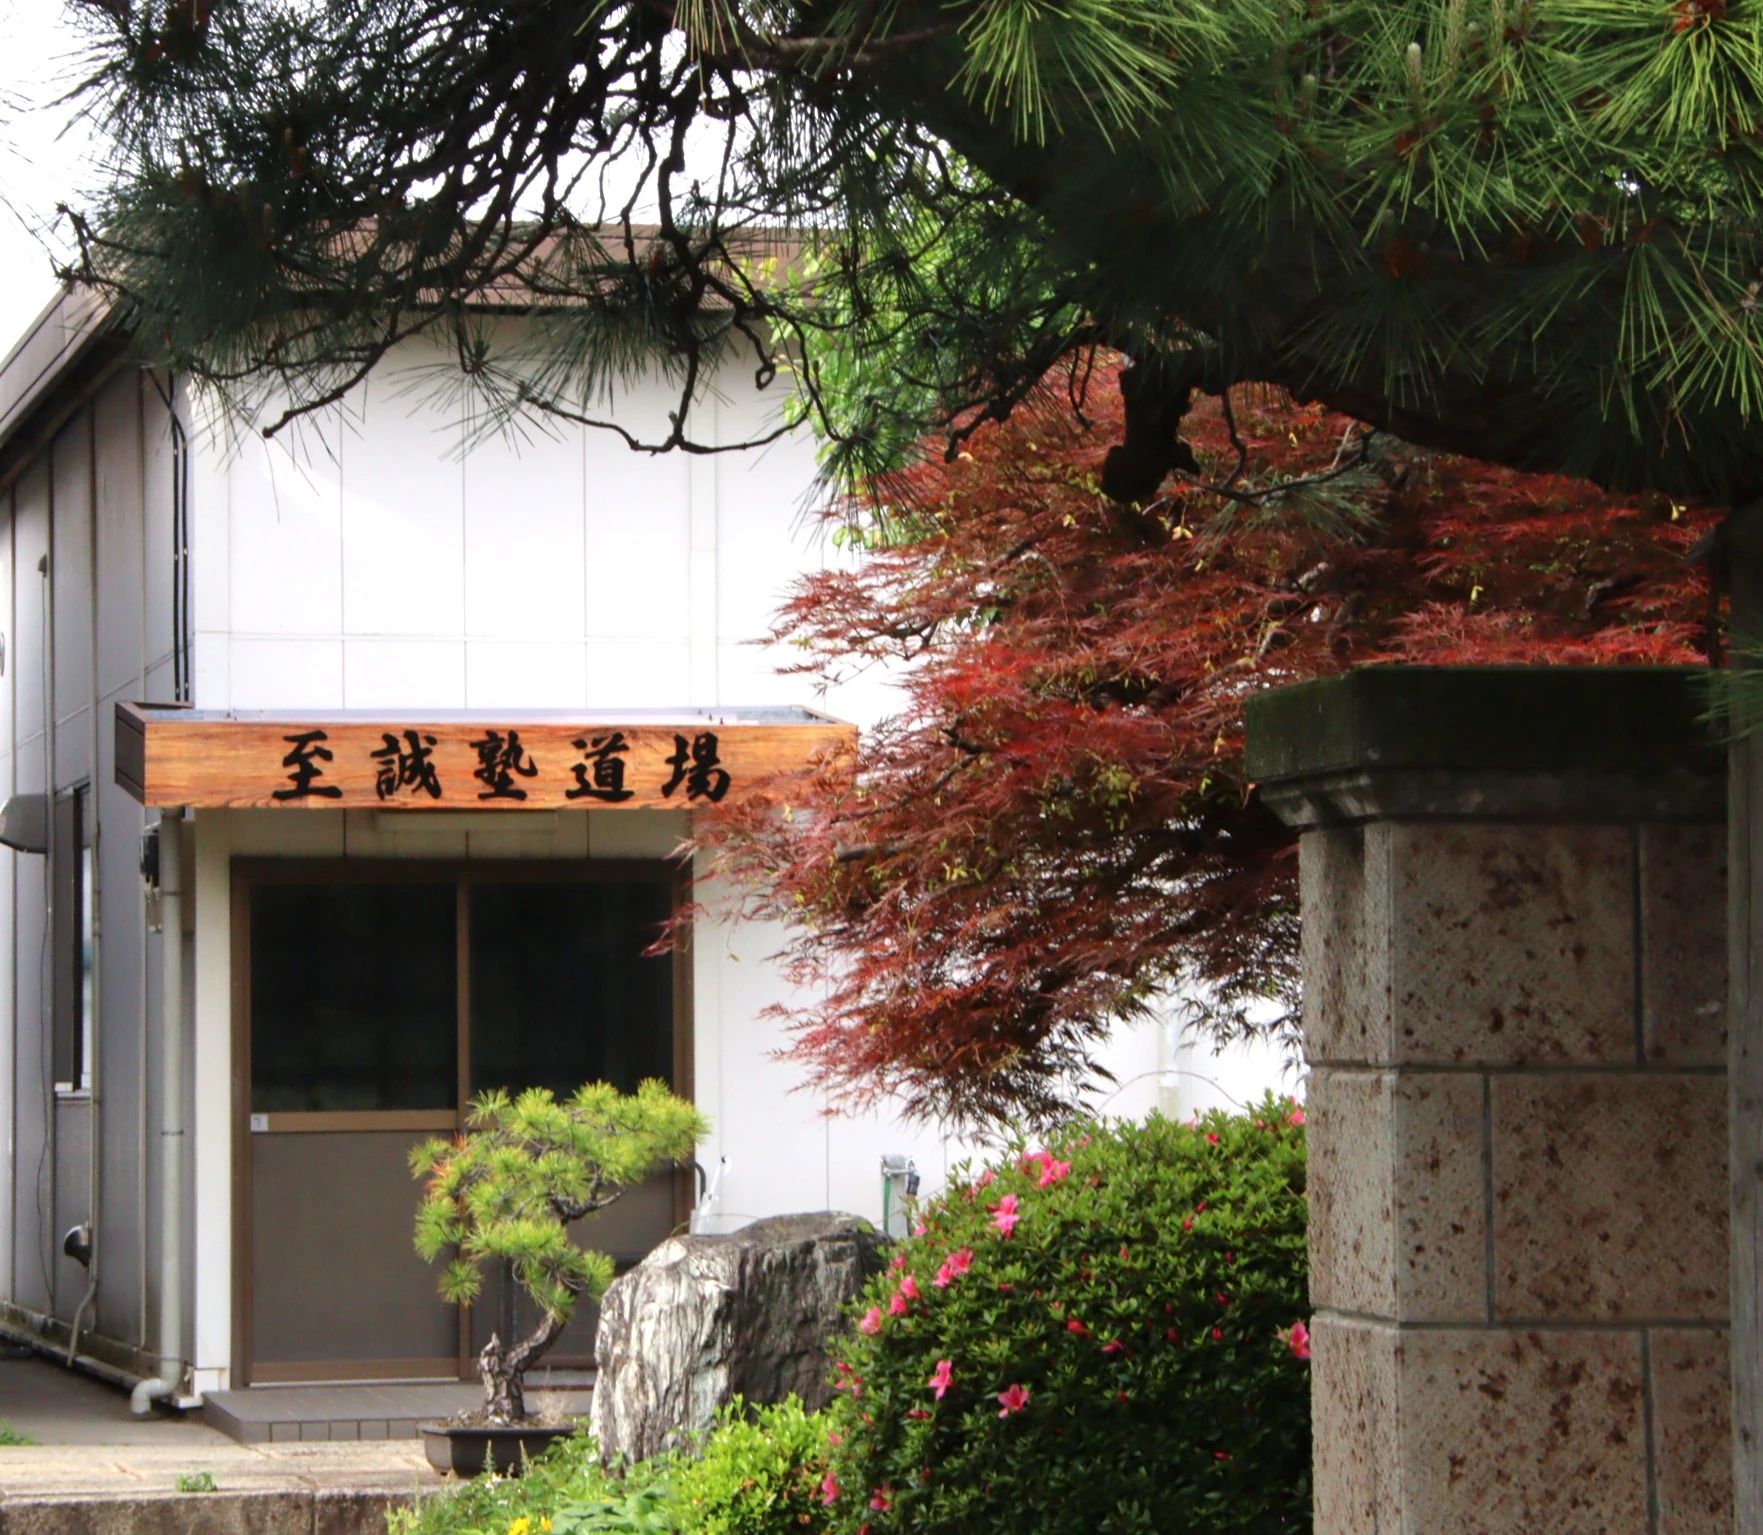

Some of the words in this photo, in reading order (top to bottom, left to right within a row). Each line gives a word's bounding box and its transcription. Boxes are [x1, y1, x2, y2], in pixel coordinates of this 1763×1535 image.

[272, 730, 732, 803] 至誠塾道場
